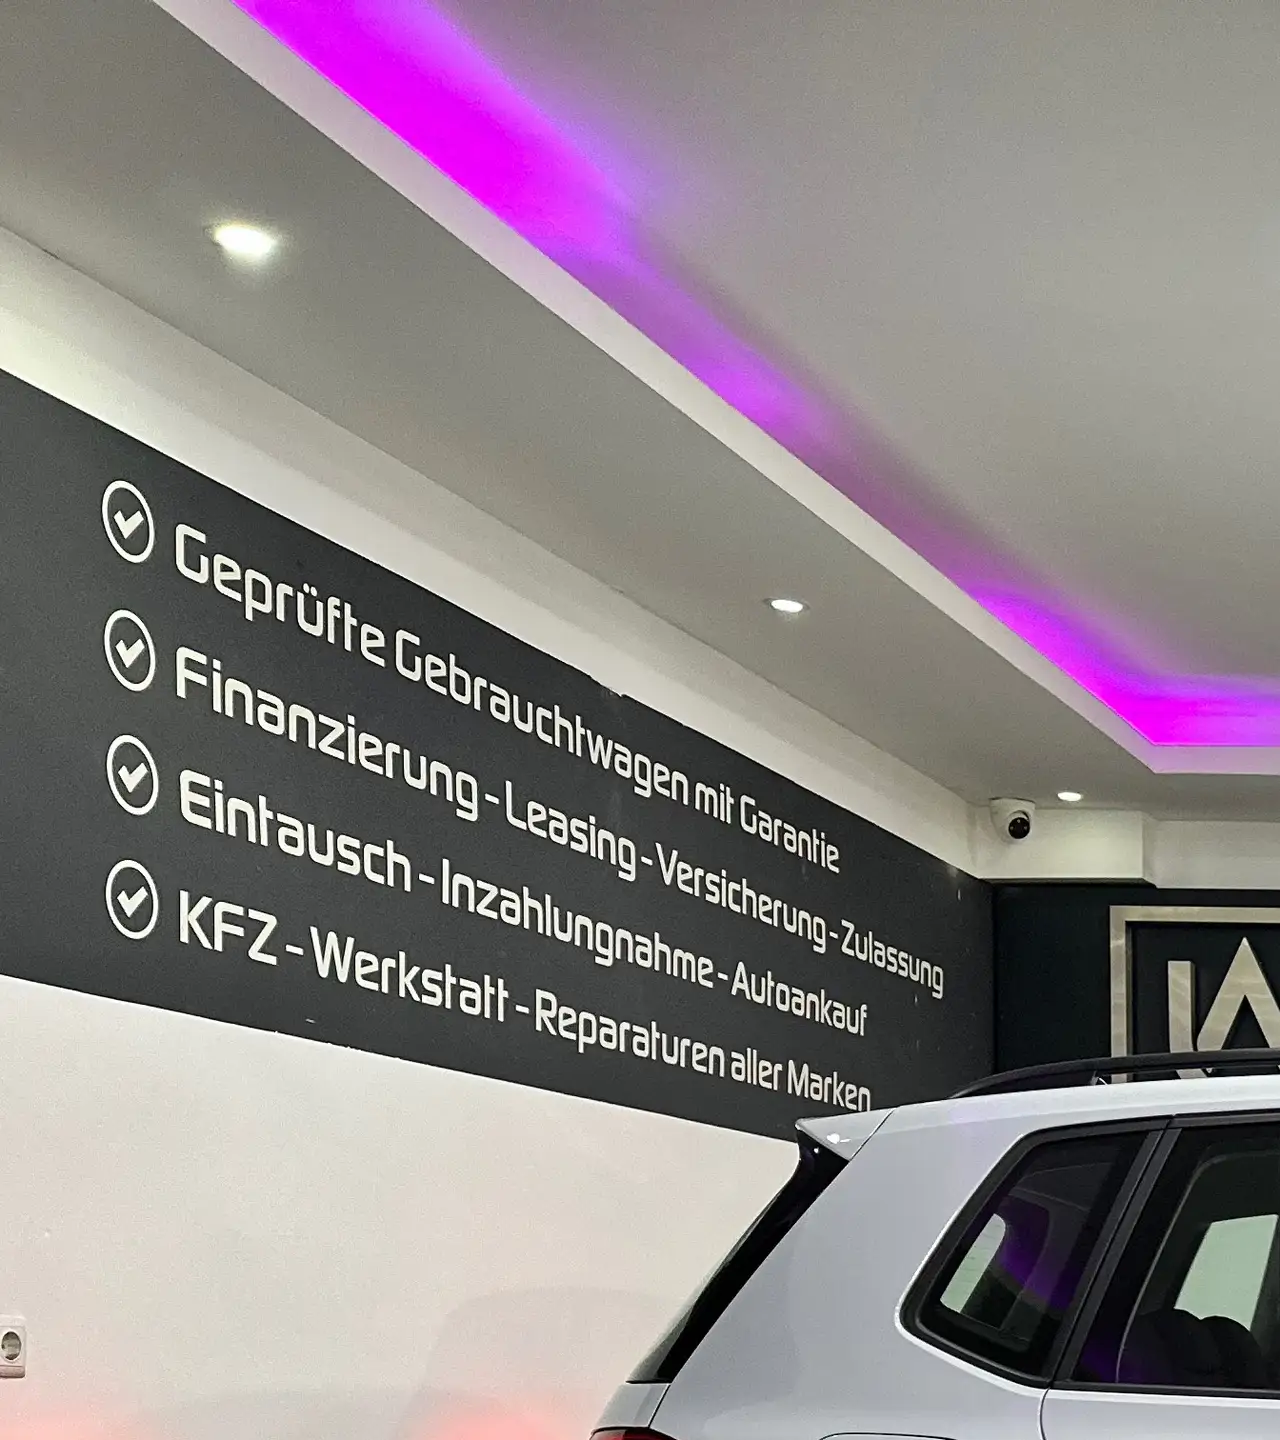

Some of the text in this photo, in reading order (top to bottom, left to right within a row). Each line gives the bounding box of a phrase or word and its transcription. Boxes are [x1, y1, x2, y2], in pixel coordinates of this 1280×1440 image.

[175, 524, 840, 873] Geprüfte Gebrauchtwagen mit Garantie
[176, 646, 478, 822] Finanzierung
[506, 780, 636, 883] Leasing
[656, 842, 826, 954] Versicherung
[841, 918, 944, 999] Zulassung
[179, 890, 277, 966] KFZ
[310, 926, 508, 1022] Werkstatt
[535, 989, 724, 1078] Reparaturen
[731, 1048, 782, 1091] aller
[788, 1060, 871, 1113] Marken
[180, 769, 411, 892] Eintausch
[442, 858, 714, 988] Inzahlungnahme
[731, 961, 867, 1036] Autoankauf
